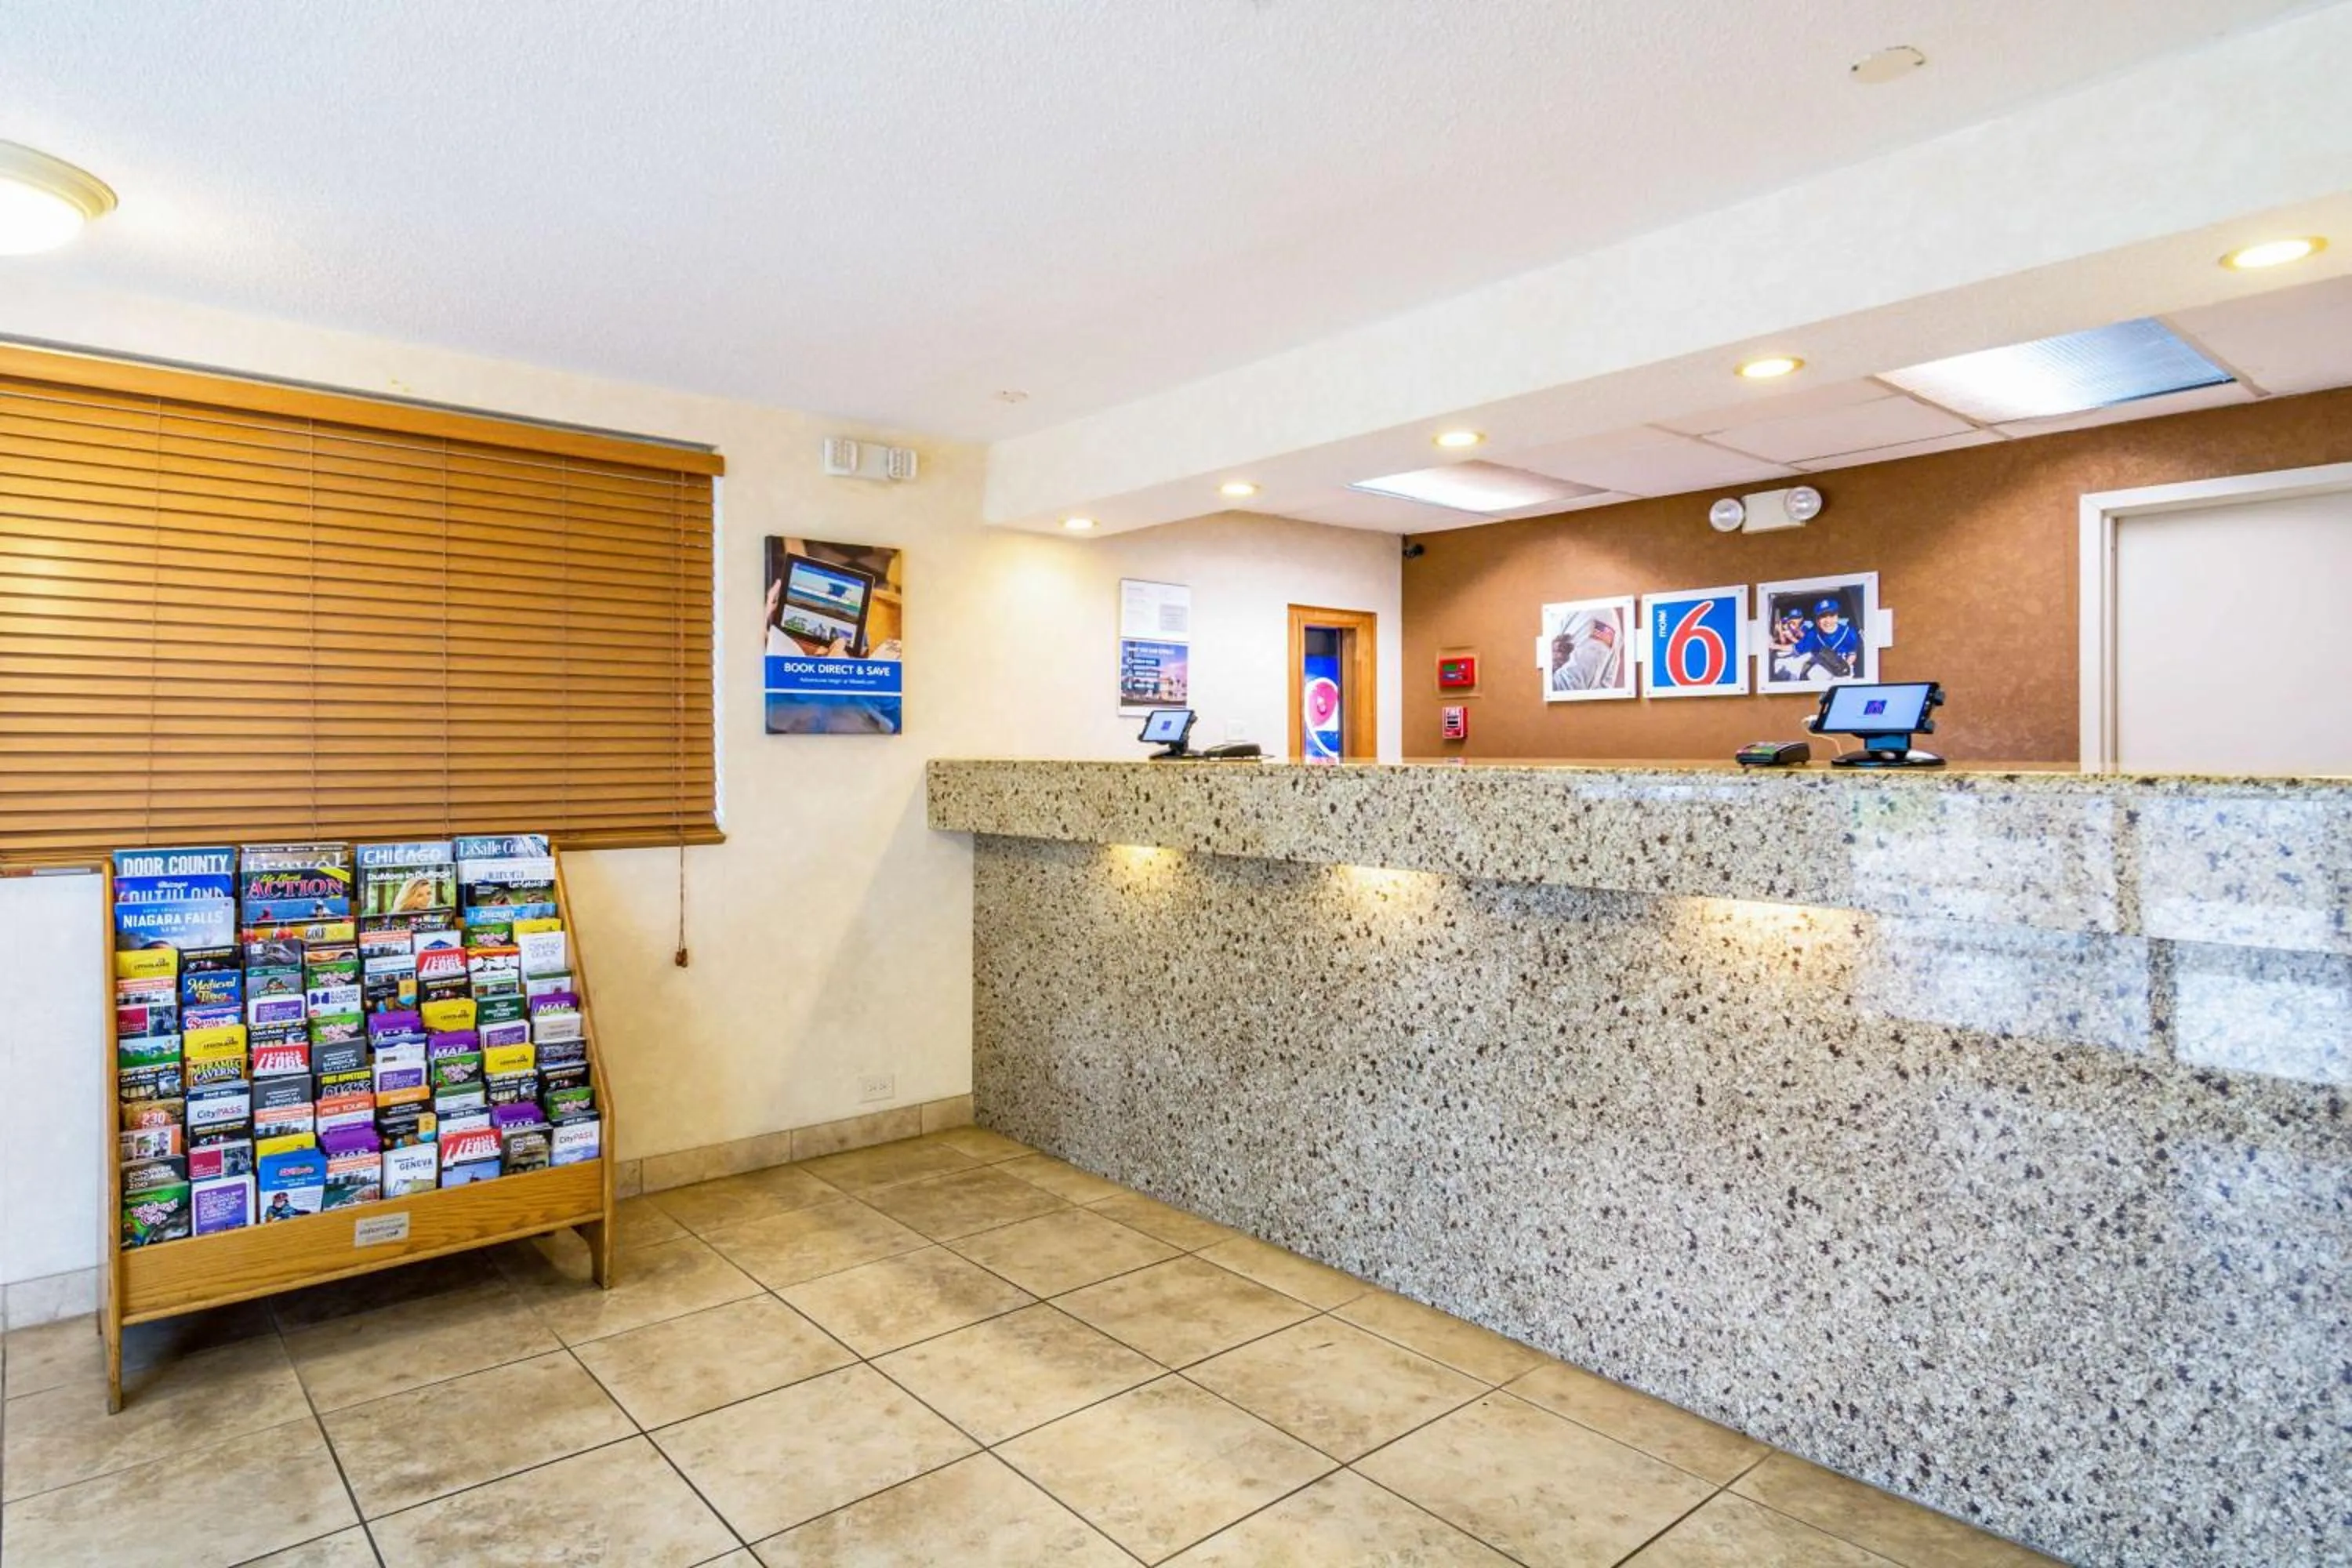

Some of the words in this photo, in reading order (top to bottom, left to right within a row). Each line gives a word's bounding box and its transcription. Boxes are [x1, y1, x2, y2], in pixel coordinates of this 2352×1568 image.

[1665, 600, 1726, 686] 6
[784, 662, 815, 673] BOOK
[818, 664, 854, 674] DIRECT
[856, 665, 864, 675] &
[866, 666, 891, 677] SAVE
[364, 849, 441, 863] CHICAGO
[123, 857, 164, 877] DOOR
[169, 855, 229, 874] COUNTY
[247, 878, 343, 898] ACTION
[123, 913, 182, 928] NIAGARA
[185, 911, 223, 924] FALLS
[187, 977, 236, 994] Medieval
[197, 1105, 242, 1120] CityPASS
[399, 1158, 433, 1171] GENEVA
